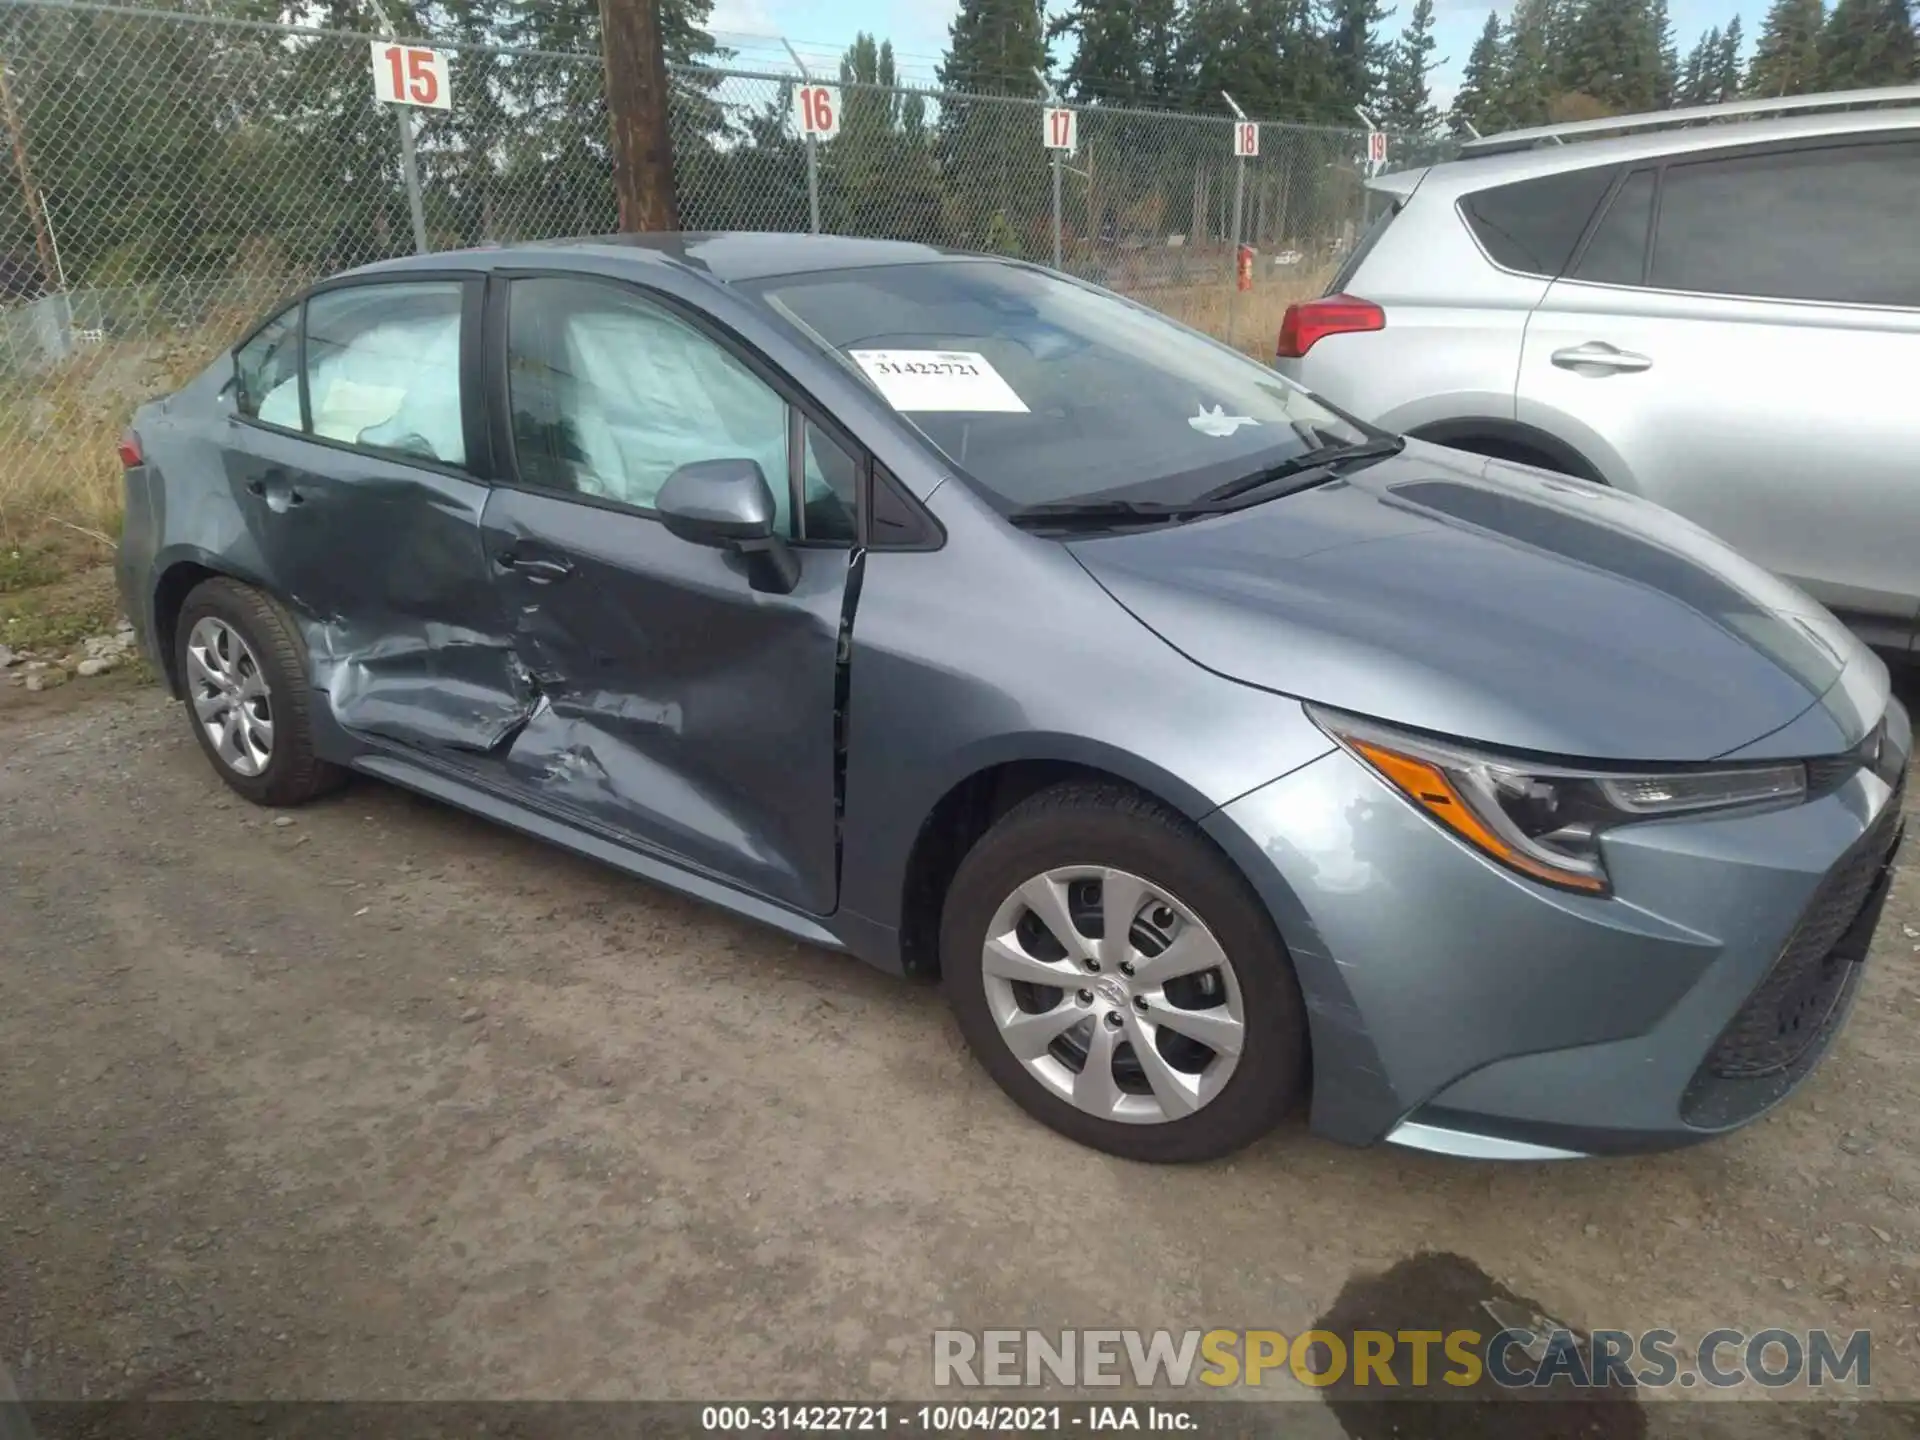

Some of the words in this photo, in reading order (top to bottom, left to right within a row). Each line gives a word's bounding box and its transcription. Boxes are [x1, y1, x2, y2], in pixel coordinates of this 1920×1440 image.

[384, 46, 438, 104] 15
[800, 87, 832, 130] 16
[1050, 111, 1070, 146] 17
[1238, 124, 1255, 154] 18
[1371, 134, 1384, 160] 19
[875, 360, 979, 376] 31422721
